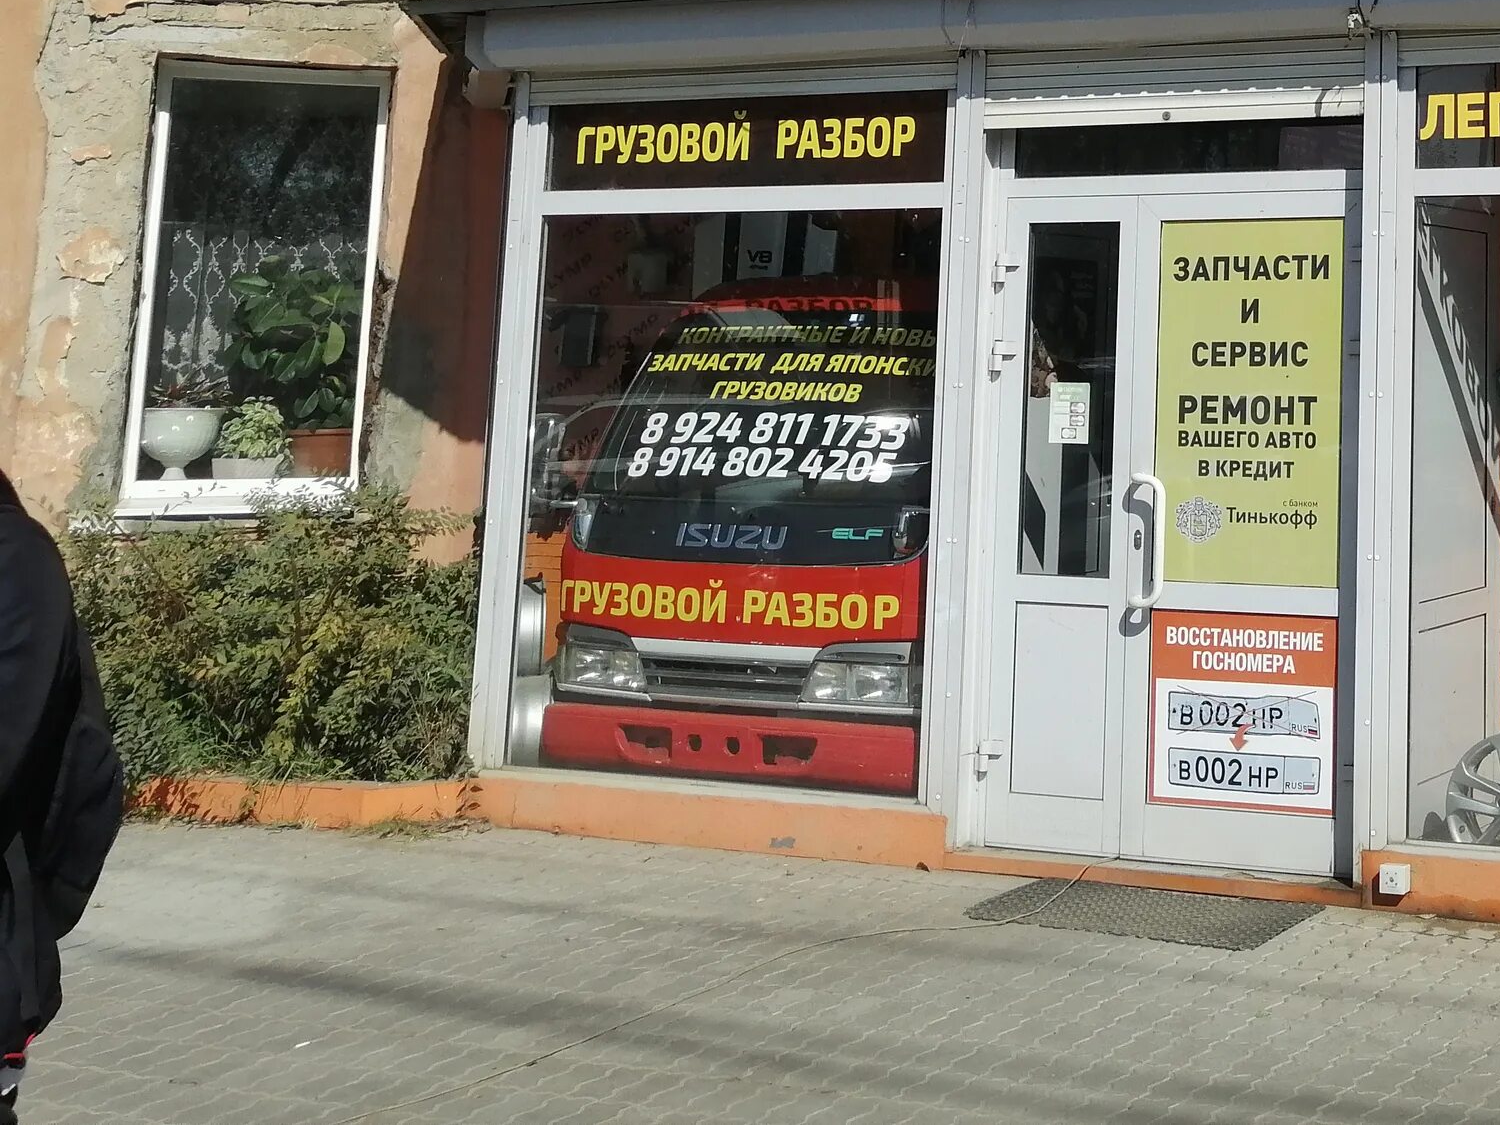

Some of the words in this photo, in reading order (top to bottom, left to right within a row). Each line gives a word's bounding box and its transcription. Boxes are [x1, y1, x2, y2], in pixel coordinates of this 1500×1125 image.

[576, 109, 751, 165] ГРУЗОВОЙ
[776, 116, 916, 160] РАЗБОР
[1172, 254, 1330, 282] ЗАПЧАСТИ
[1240, 298, 1260, 324] И
[678, 325, 848, 346] КОНТРАКТНЫЕ
[849, 326, 871, 346] И
[648, 353, 763, 373] ЗАПЧАСТИ
[771, 353, 824, 376] ДЛЯ
[1191, 341, 1309, 367] СЕРВИС
[710, 381, 863, 403] ГРУЗОВИКОВ
[1177, 395, 1318, 426] РЕМОНТ
[640, 412, 669, 444] 8
[670, 412, 744, 444] 924
[749, 412, 815, 445] 811
[821, 414, 910, 450] 1733
[1177, 429, 1260, 448] ВАШЕГО
[1264, 431, 1318, 449] АВТО
[628, 446, 654, 476] 8
[655, 446, 717, 477] 914
[722, 446, 795, 478] 802
[1198, 460, 1210, 477] В
[1215, 460, 1295, 480] КРЕДИТ
[1289, 498, 1319, 507] банком
[1226, 506, 1318, 530] Тинькофф
[675, 522, 788, 550] ISUZU
[831, 527, 884, 541] ELF
[560, 579, 727, 624] ГРУЗОВОЙ
[742, 590, 900, 630] РАЗБОР
[1165, 626, 1324, 652] ВОССТАНОВЛЕНИЕ
[1192, 650, 1296, 675] ГОСНОМЕРА
[1291, 723, 1308, 734] RUS
[1285, 781, 1303, 791] RUS
